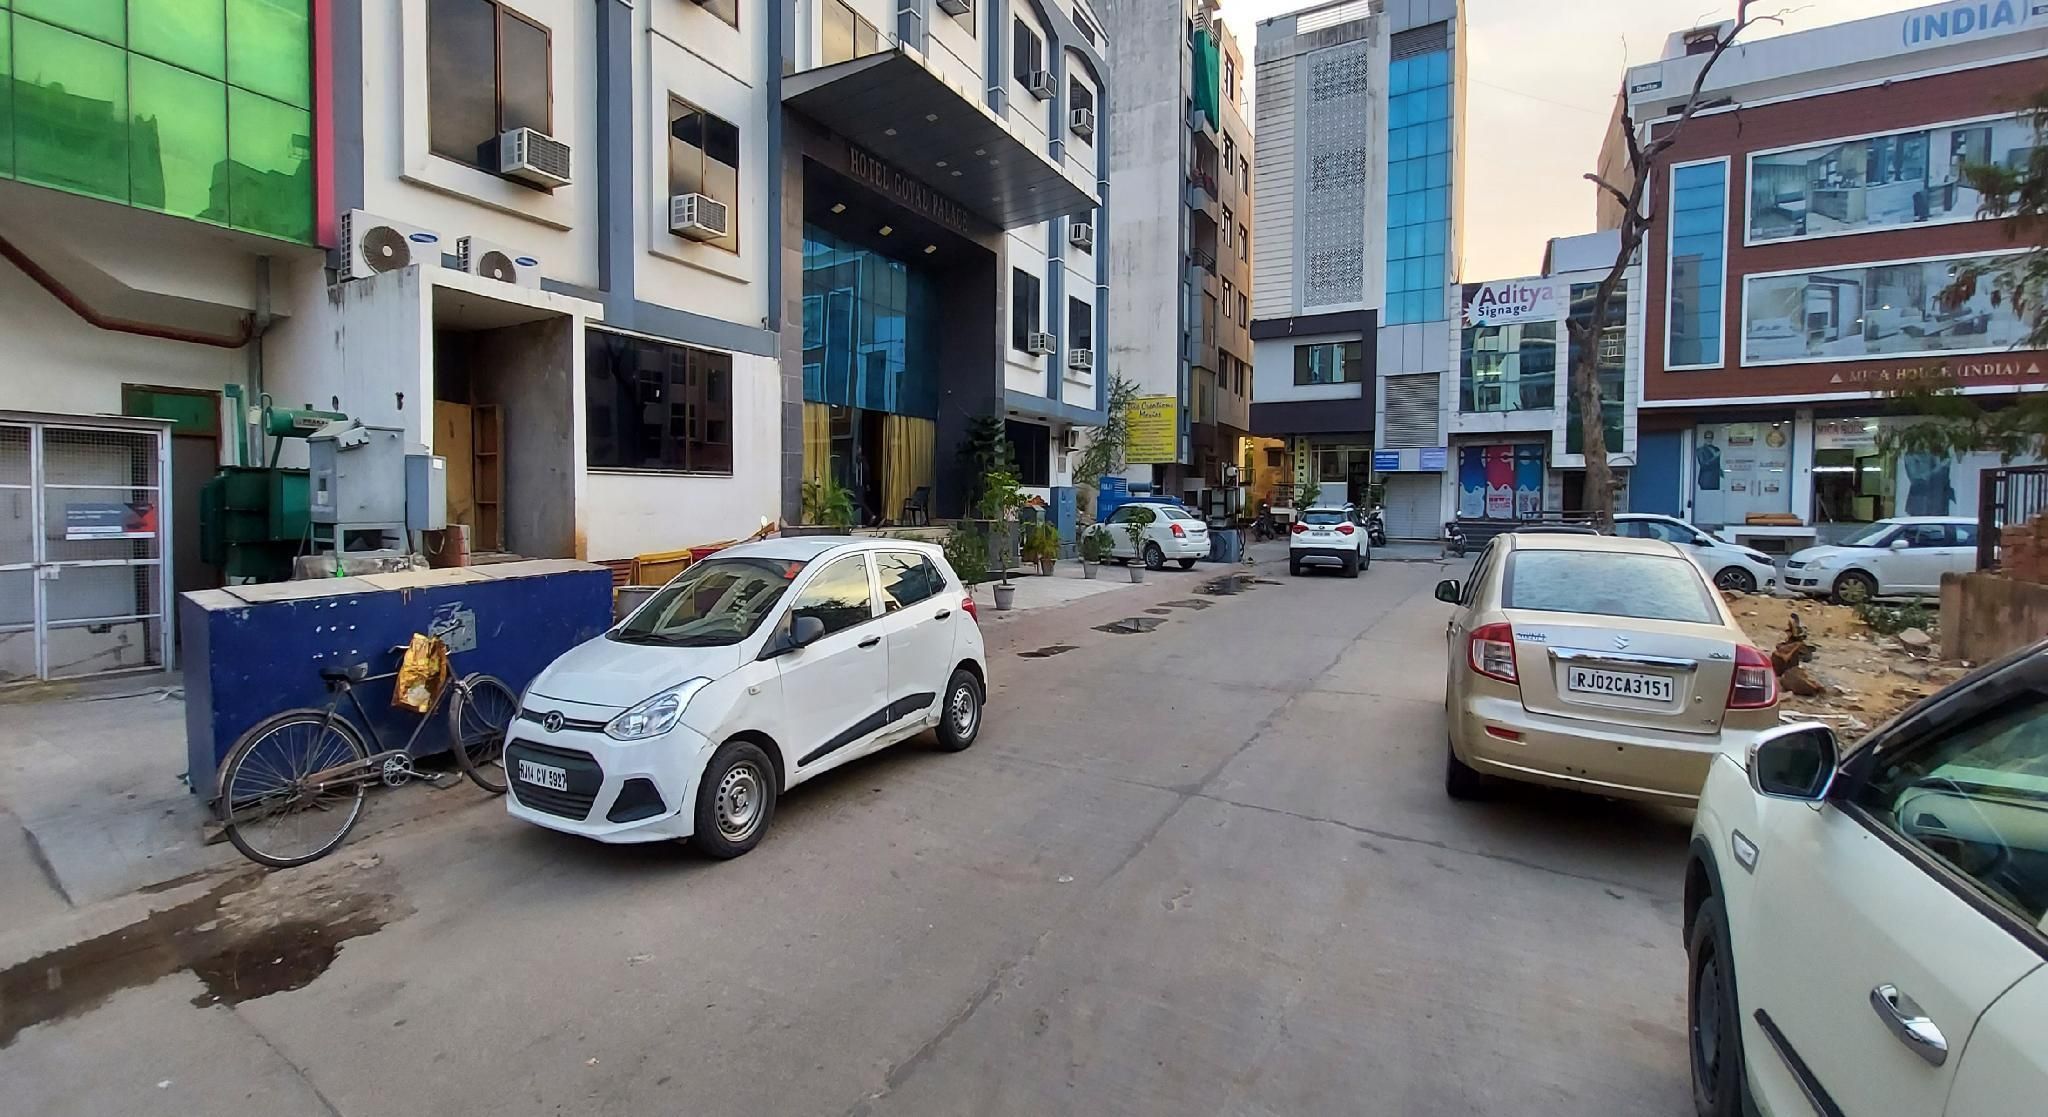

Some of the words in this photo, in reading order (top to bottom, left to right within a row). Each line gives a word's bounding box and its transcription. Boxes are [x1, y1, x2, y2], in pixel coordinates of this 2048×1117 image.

[1903, 0, 2028, 47] (INDIA)
[850, 147, 889, 190] HOTEL
[894, 173, 928, 210] GOYAL
[932, 193, 968, 232] PALACE
[1479, 284, 1553, 311] Aditya
[1478, 305, 1527, 318] Signage
[1957, 362, 2020, 377] (INDIA)
[1577, 672, 1670, 698] RJ02CA3151
[519, 763, 534, 780] RJ14
[537, 766, 546, 783] CV
[549, 770, 566, 789] 5927
